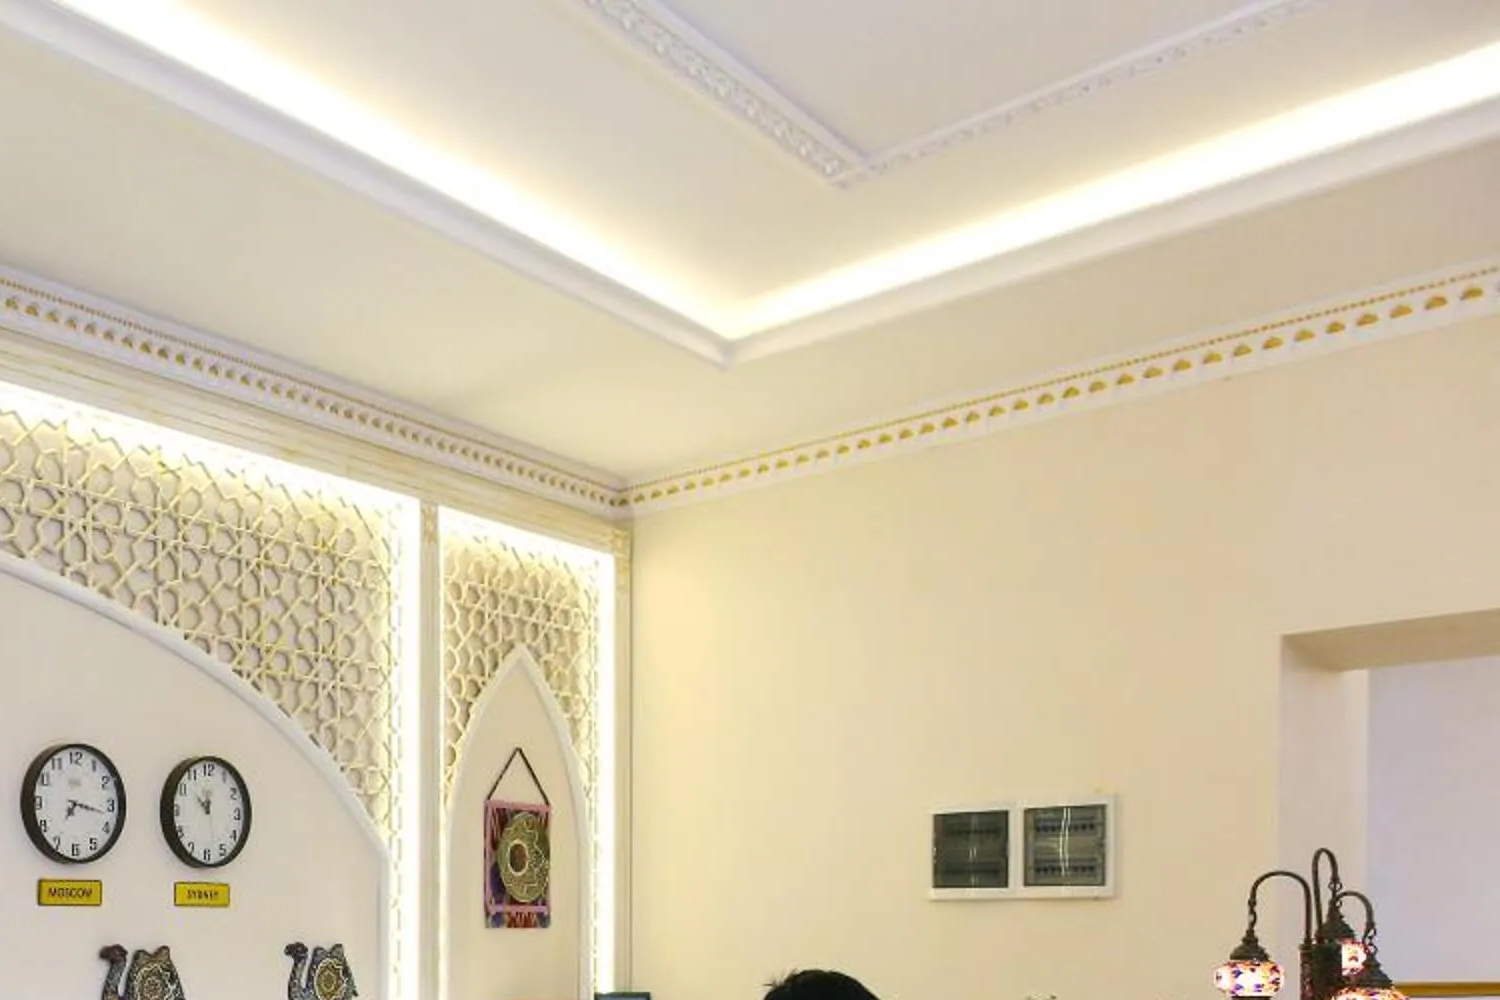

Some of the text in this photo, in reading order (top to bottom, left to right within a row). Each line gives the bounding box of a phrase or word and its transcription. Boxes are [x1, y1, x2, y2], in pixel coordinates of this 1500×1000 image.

[69, 752, 83, 765] 12
[203, 764, 215, 776] 12
[101, 776, 110, 789] 2
[107, 799, 114, 812] 3
[102, 822, 110, 834] 4
[71, 844, 80, 856] 6
[89, 838, 97, 850] 5
[48, 887, 93, 899] MOSCOW
